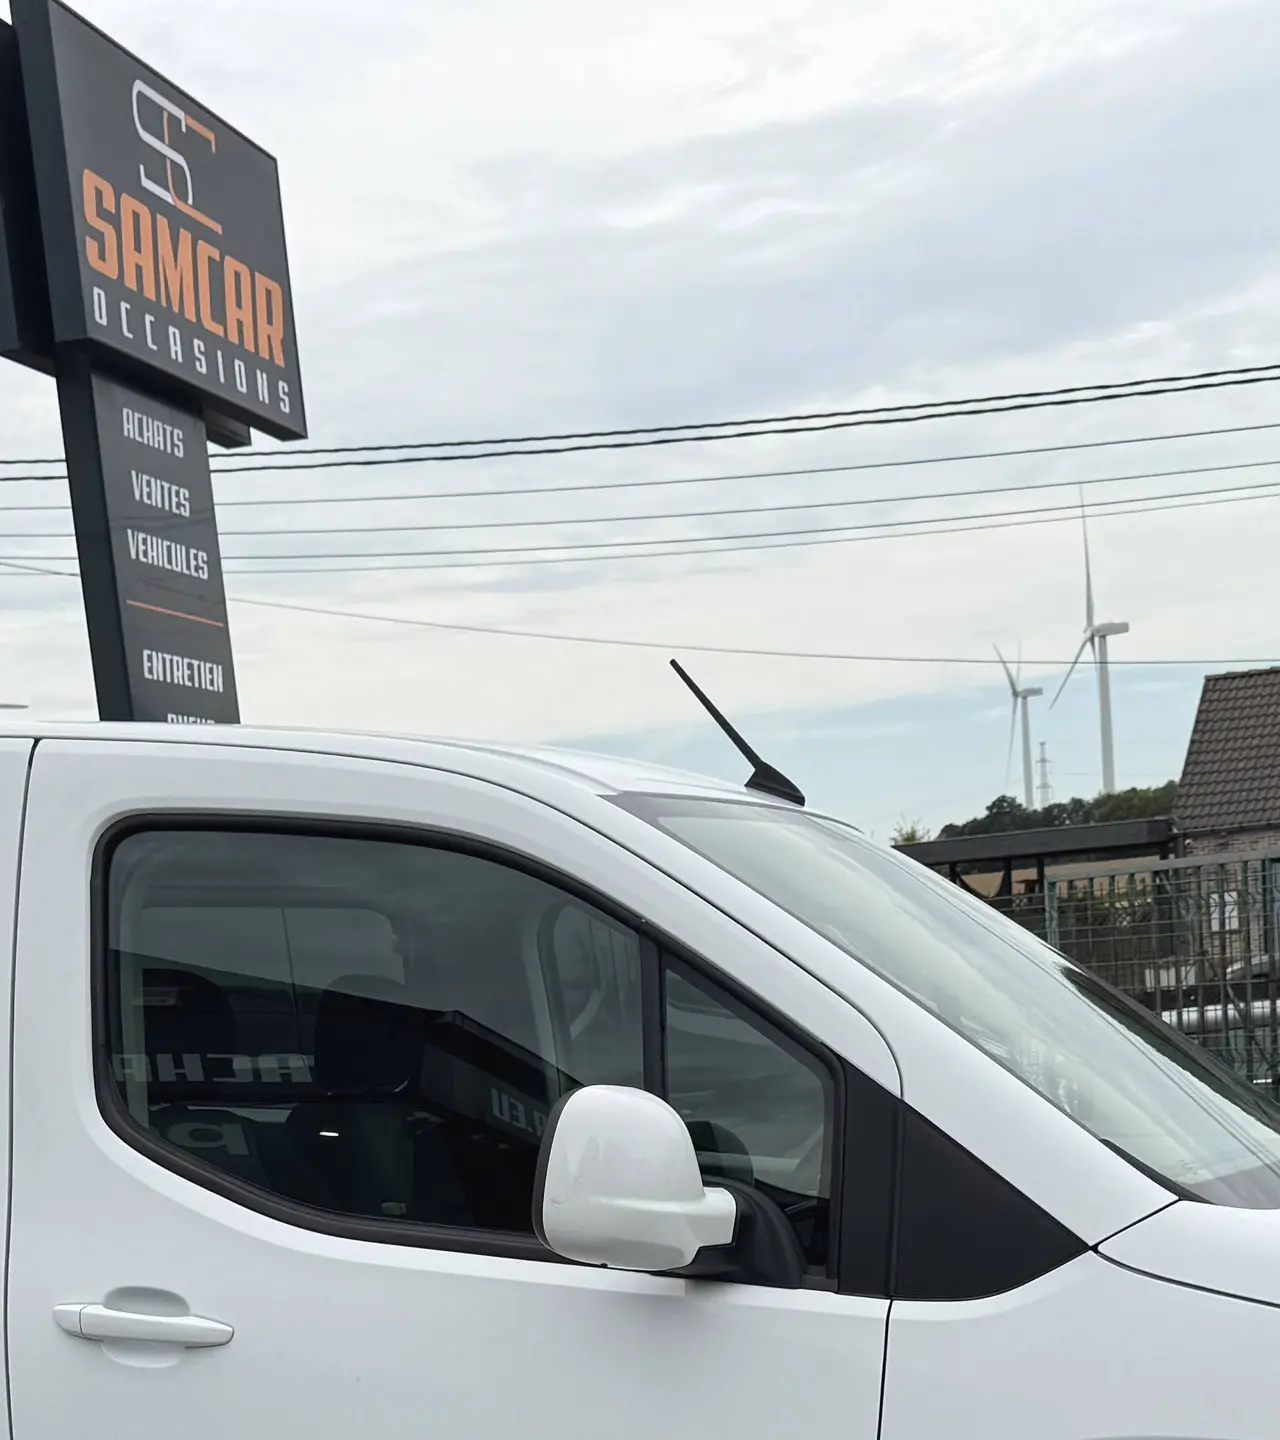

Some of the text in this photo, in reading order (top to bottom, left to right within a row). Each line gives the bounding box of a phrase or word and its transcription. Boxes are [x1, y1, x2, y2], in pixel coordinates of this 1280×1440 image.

[82, 168, 285, 367] SAMCAR
[93, 286, 290, 414] OCCASIONS
[122, 407, 184, 458] ACHATS
[131, 470, 190, 517] VENTES
[127, 528, 208, 580] VEHICULES
[143, 649, 224, 693] ENTRETIEN
